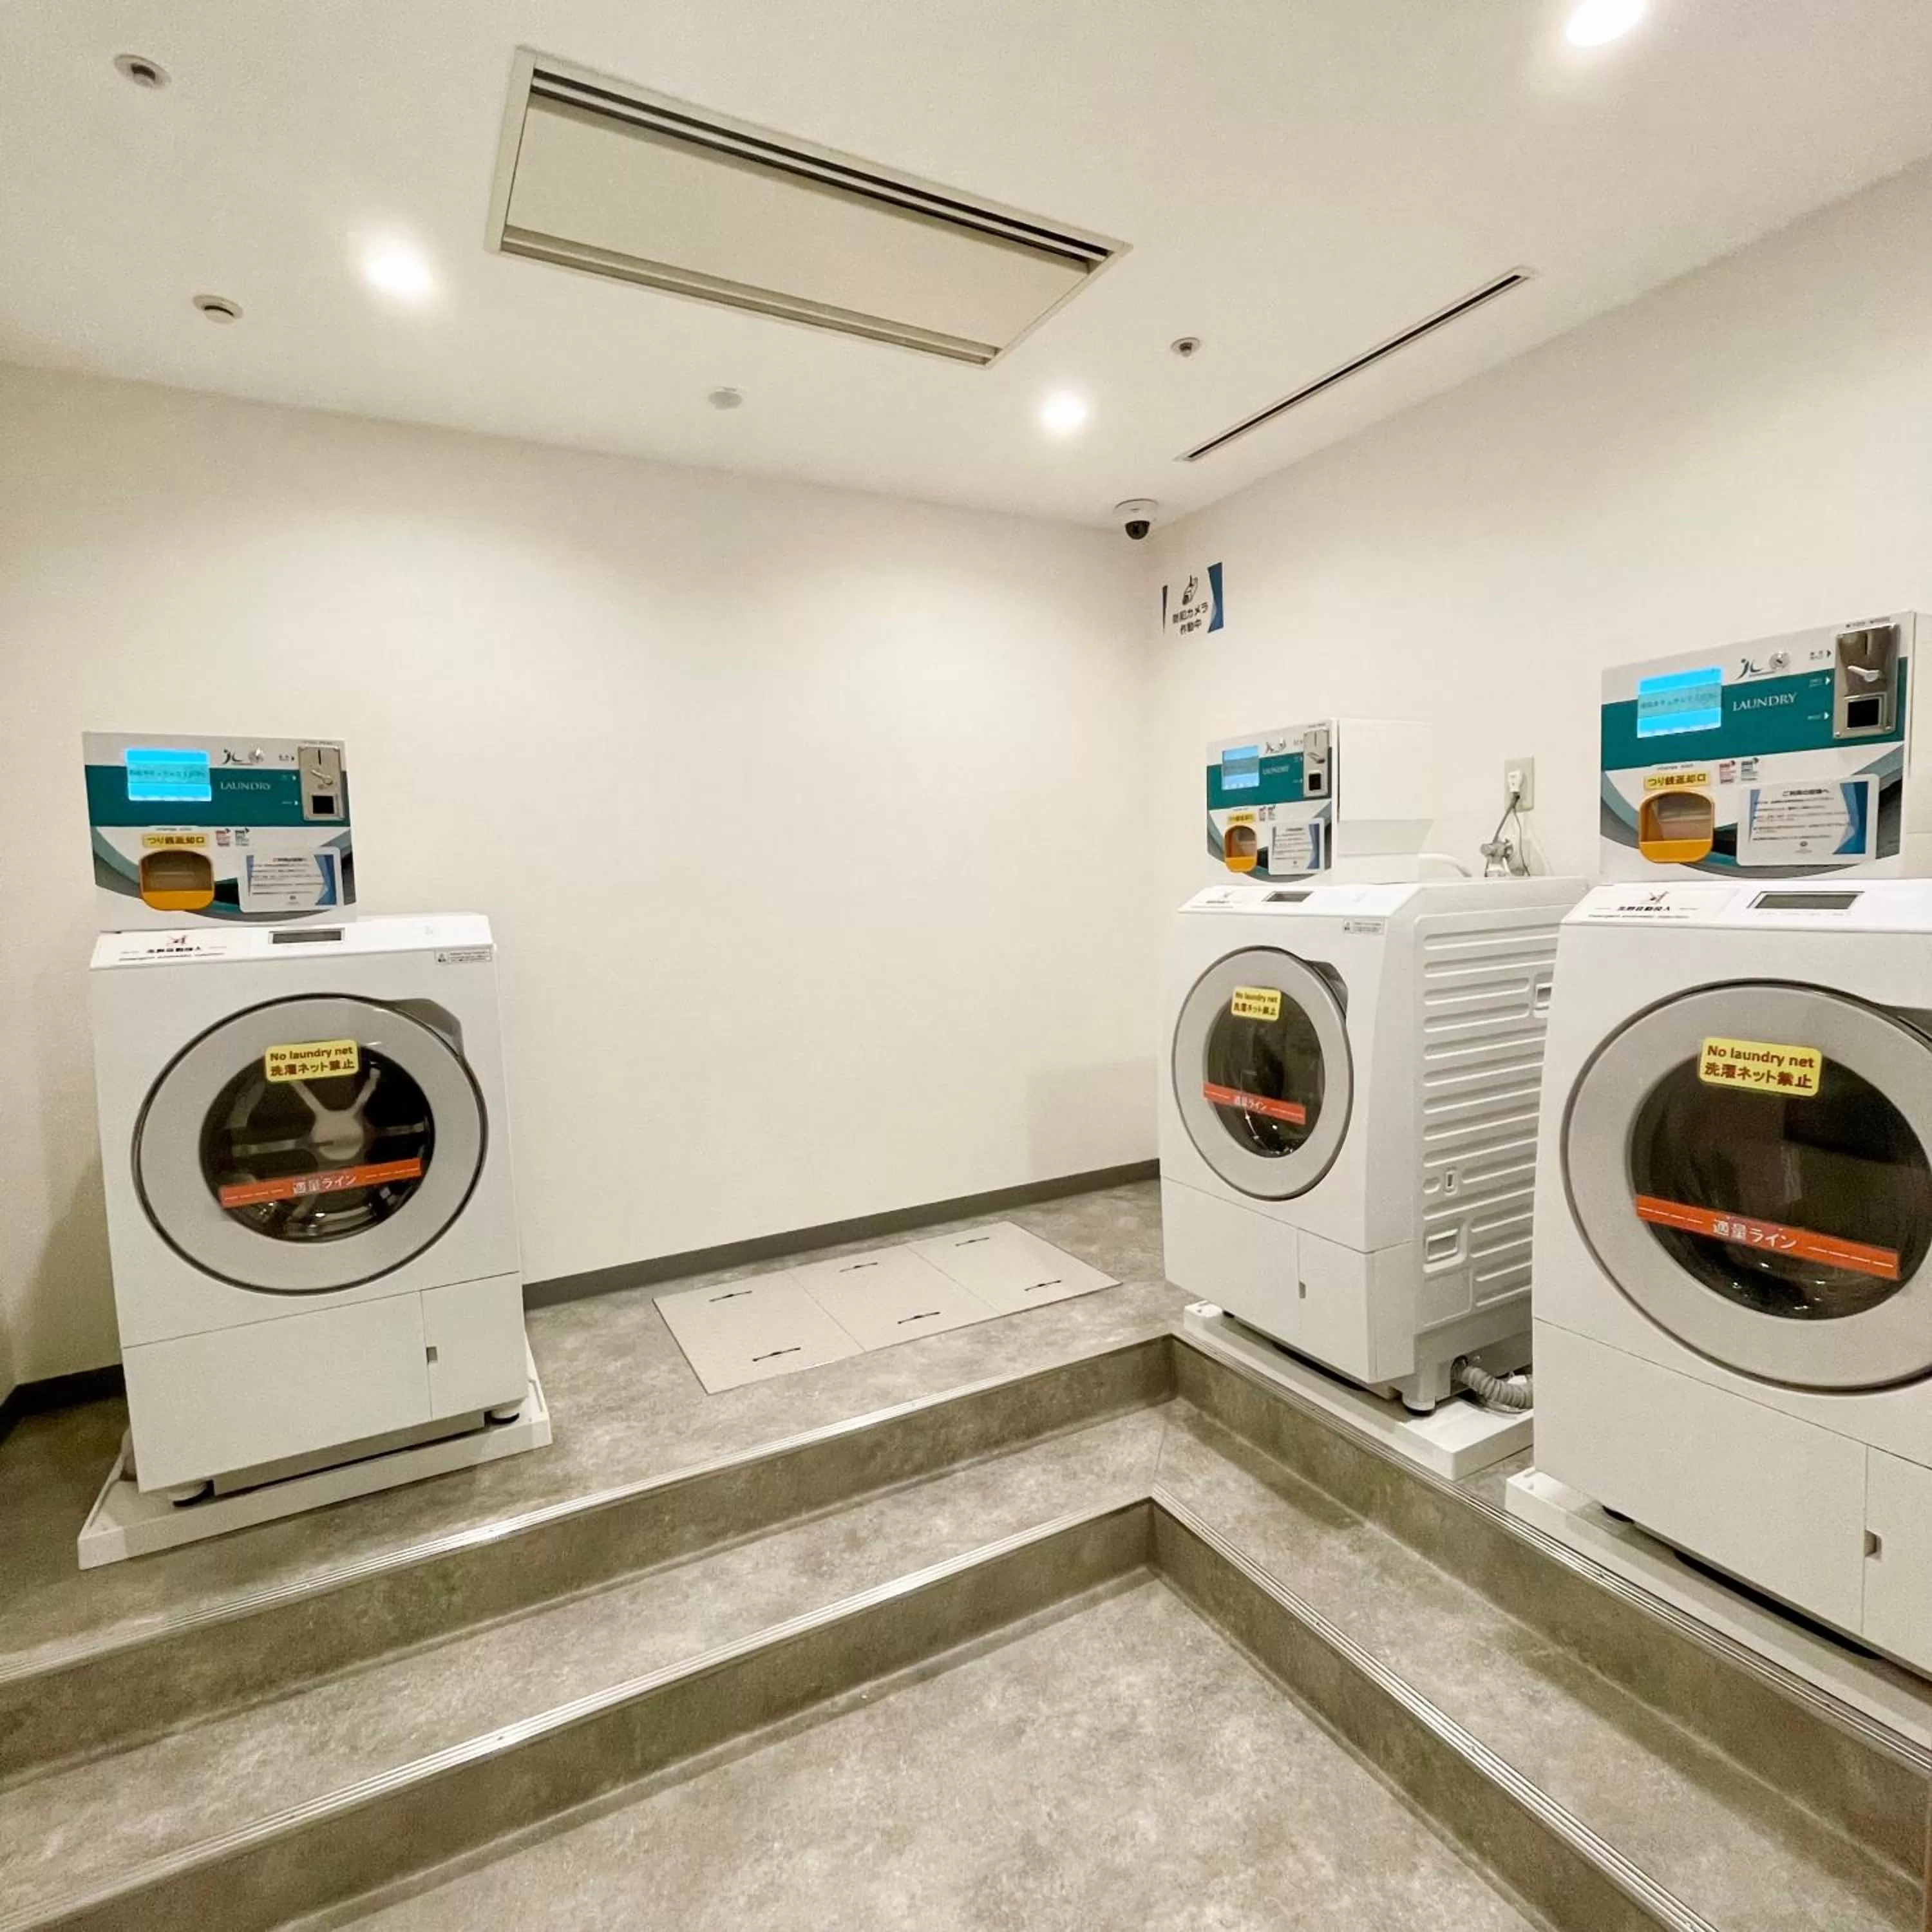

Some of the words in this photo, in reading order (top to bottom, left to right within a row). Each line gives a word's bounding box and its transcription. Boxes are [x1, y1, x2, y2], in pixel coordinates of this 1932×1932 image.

[1732, 692, 1797, 711] LAUNDRY
[220, 781, 270, 790] LAUNDRY
[270, 1053, 287, 1061] No
[290, 1048, 332, 1060] laundry
[335, 1046, 353, 1055] net
[1707, 1045, 1727, 1057] No
[1730, 1048, 1785, 1066] laundry
[1788, 1056, 1814, 1068] net
[270, 1059, 355, 1076] 洗濯ネット禁止
[1705, 1062, 1813, 1088] 洗濯ネット禁止
[292, 1175, 357, 1195] 適量ライン
[1712, 1218, 1797, 1249] 適量ライン
